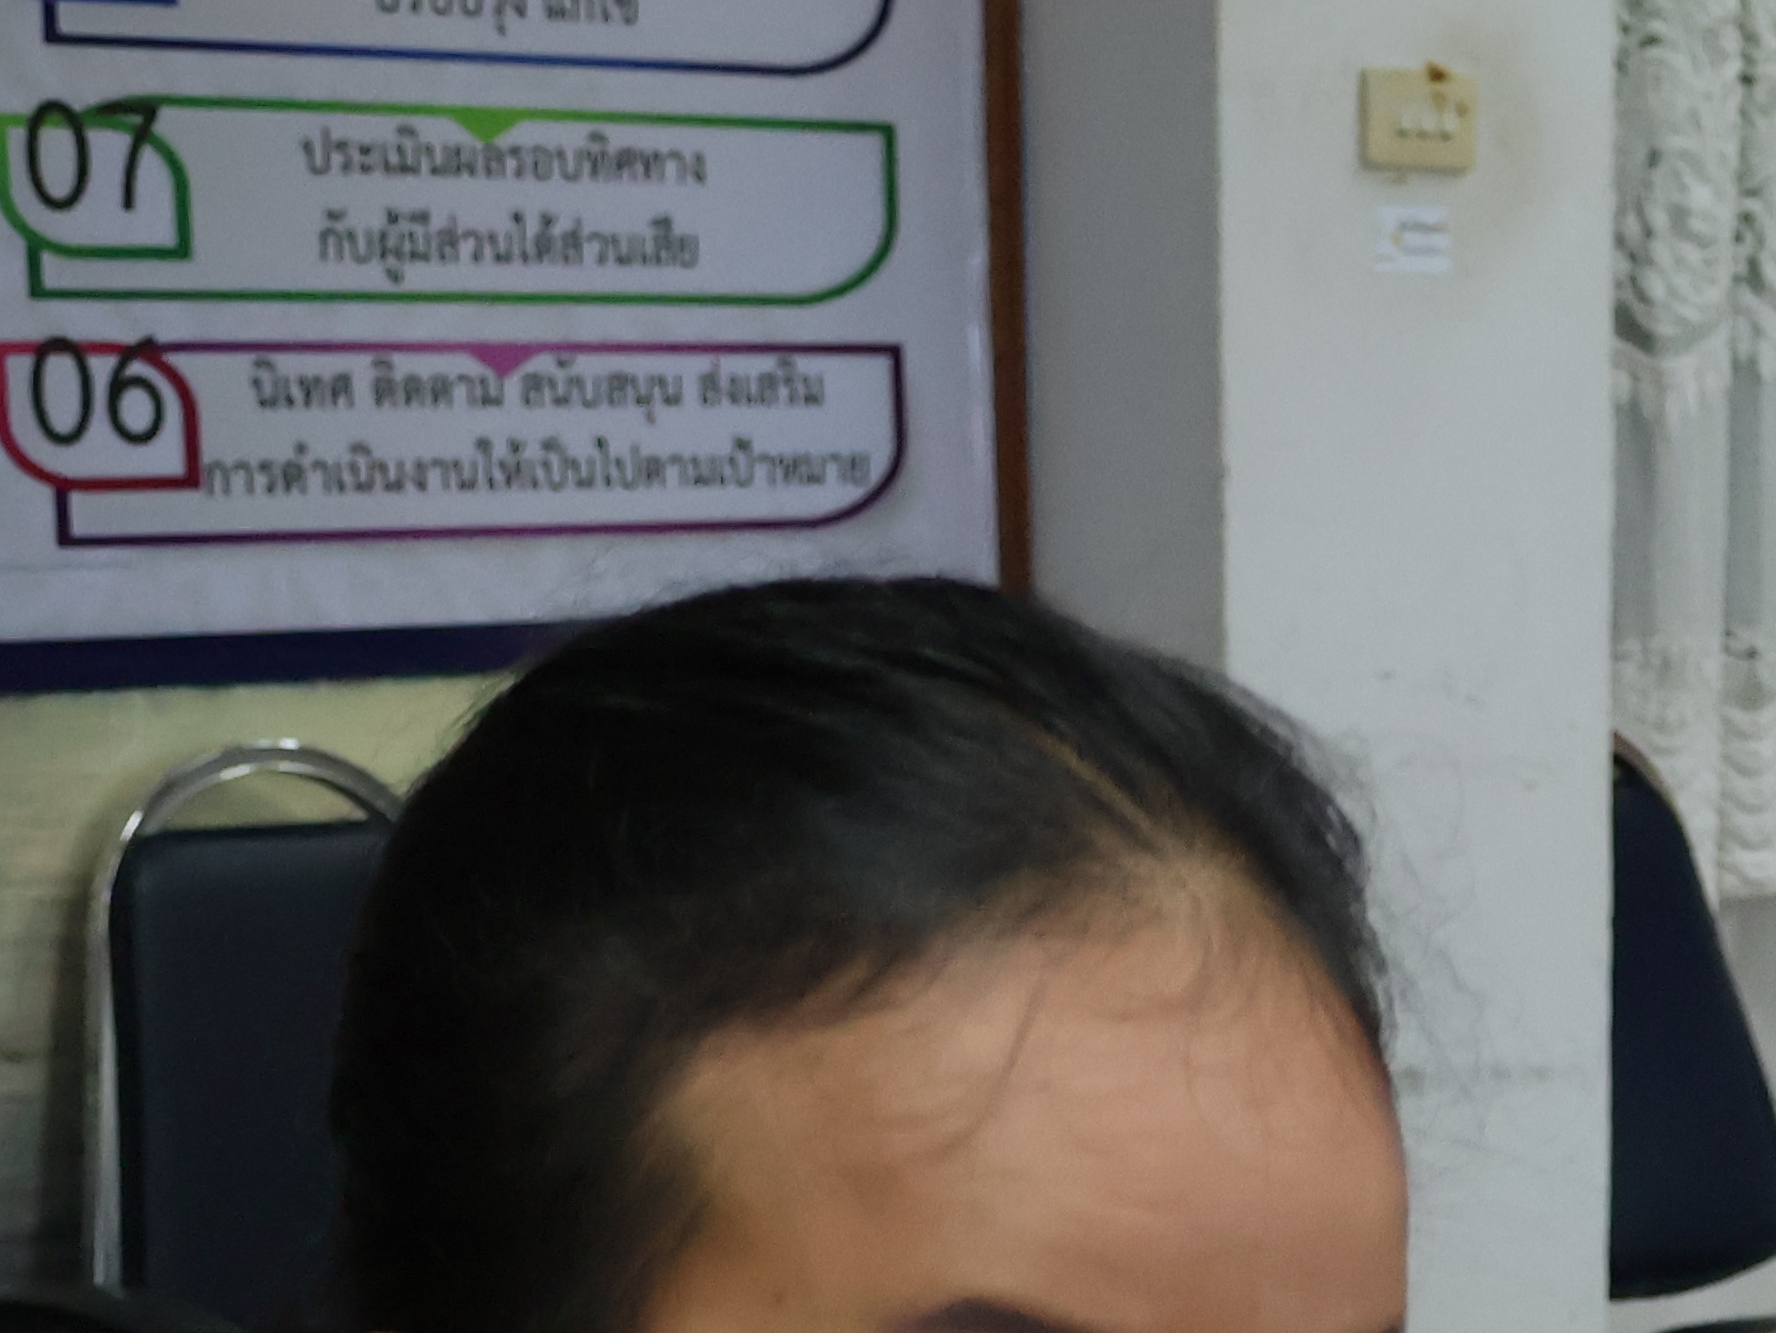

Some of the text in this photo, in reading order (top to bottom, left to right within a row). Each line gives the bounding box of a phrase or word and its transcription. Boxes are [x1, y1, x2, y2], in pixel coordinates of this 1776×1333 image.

[27, 101, 158, 212] 07
[302, 124, 708, 186] ประเมินผลรอบทิศทาง
[318, 208, 700, 286] กับผู้มีส่วนได้ส่วนเสีย
[32, 335, 164, 446] 06
[249, 355, 353, 409] นิเทศ
[520, 354, 684, 424] สนับสนุน
[202, 434, 873, 495] การดำเนินงานให้เป็นไปตามเป้าหมาย
